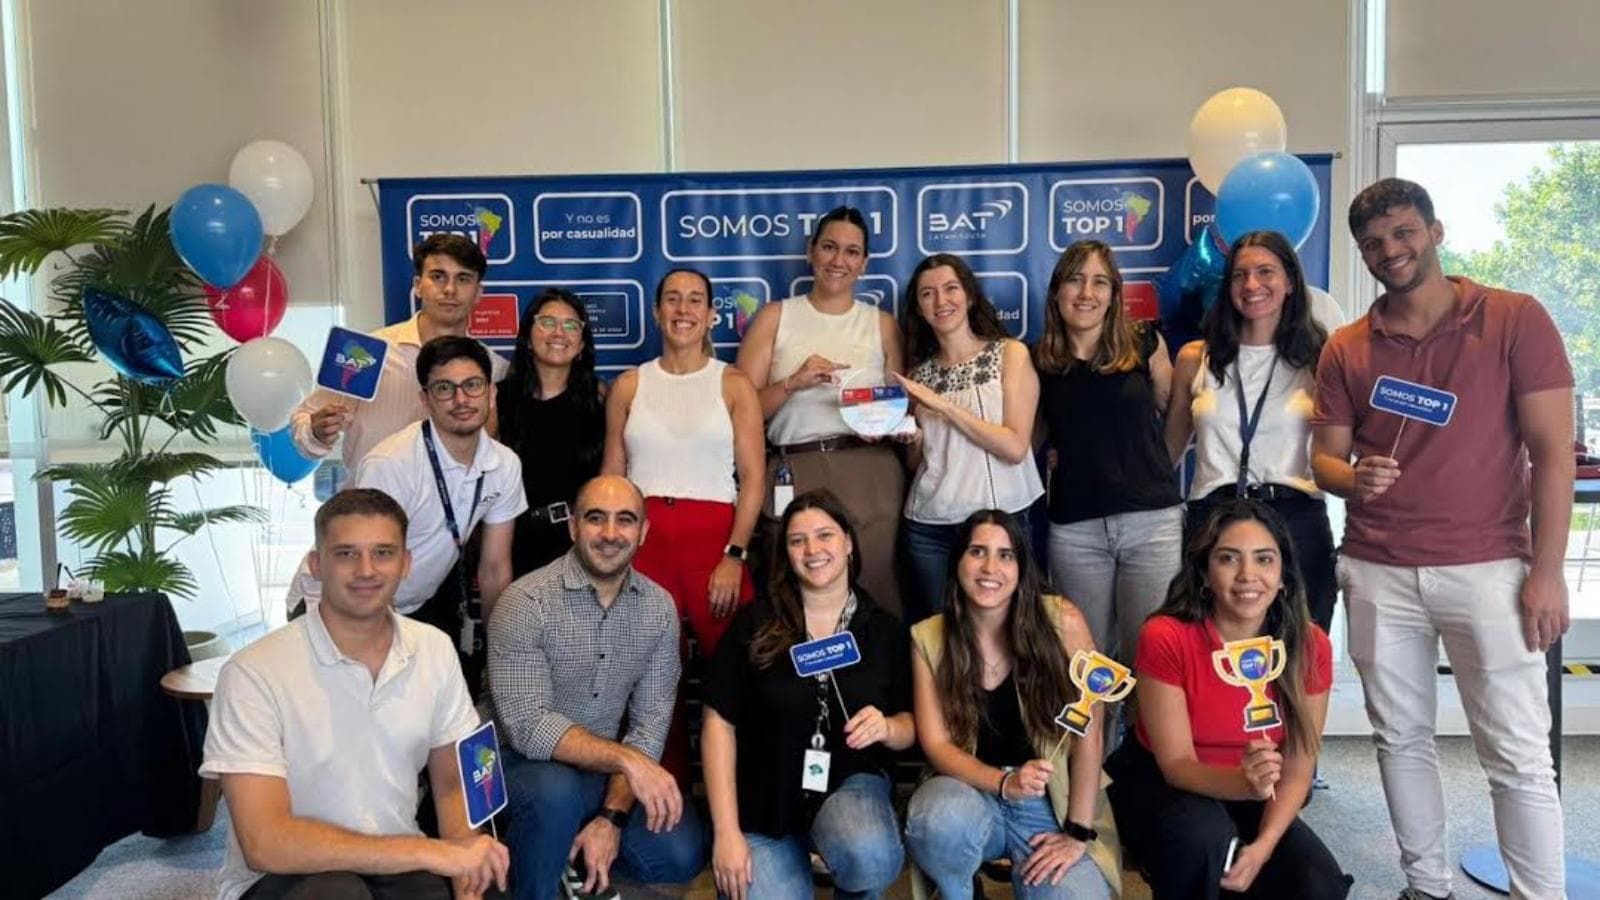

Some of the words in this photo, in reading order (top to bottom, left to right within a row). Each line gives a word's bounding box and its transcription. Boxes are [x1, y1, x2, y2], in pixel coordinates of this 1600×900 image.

[1063, 199, 1124, 214] SOMOS
[420, 213, 478, 228] SOMOS
[565, 213, 573, 224] Y
[576, 214, 594, 223] no
[596, 214, 610, 223] es
[679, 213, 790, 239] SOMOS
[929, 211, 994, 232] BAT
[1062, 216, 1110, 235] TOP
[1115, 215, 1124, 232] 1
[1193, 213, 1215, 226] por
[542, 229, 563, 242] por
[566, 226, 636, 240] casualidad
[1380, 386, 1416, 402] SOMOS
[1418, 395, 1441, 409] TOP
[826, 643, 845, 654] TOP
